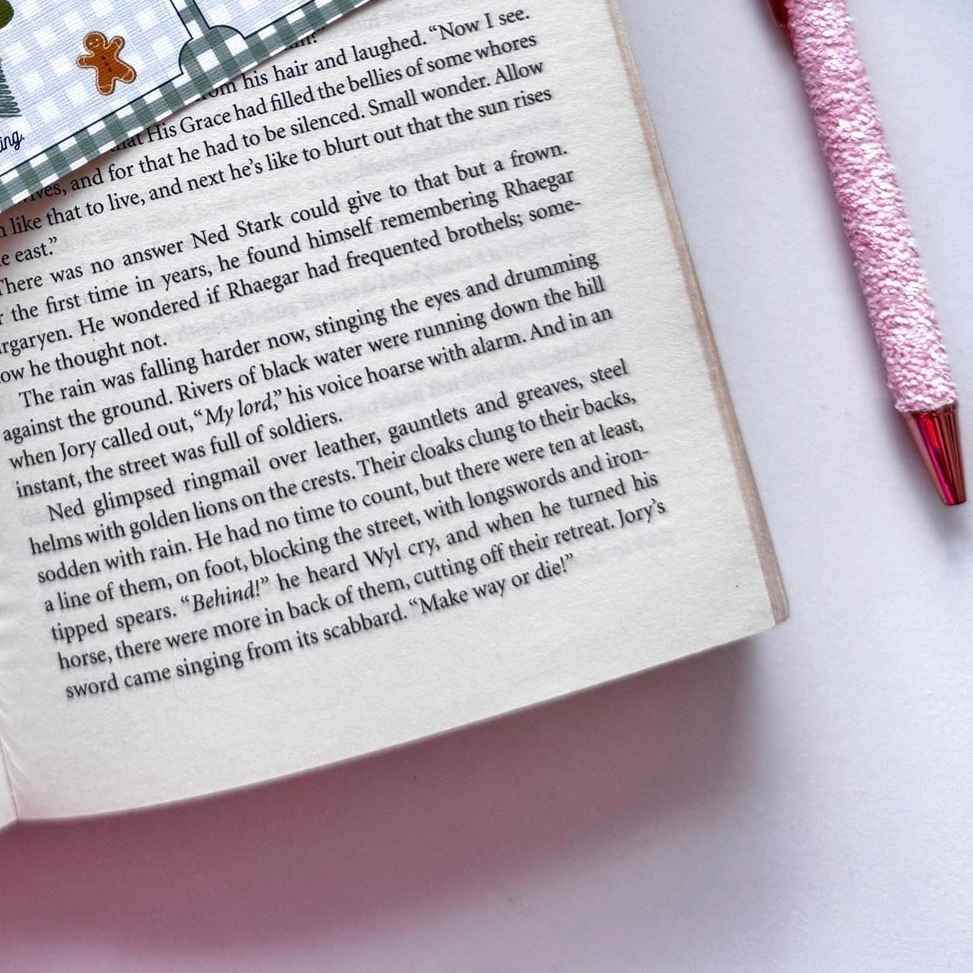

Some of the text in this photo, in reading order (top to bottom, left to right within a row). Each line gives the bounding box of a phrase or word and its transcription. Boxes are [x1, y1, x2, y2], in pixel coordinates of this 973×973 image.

[49, 264, 84, 284] was
[90, 257, 115, 275] no
[121, 239, 184, 267] answer
[189, 223, 231, 250] Ned
[235, 210, 285, 238] Stark
[290, 195, 341, 224] could
[347, 189, 383, 215] give
[387, 183, 408, 199] to
[413, 170, 451, 192] that
[454, 161, 488, 182] but
[493, 159, 506, 172] a
[510, 144, 568, 168] frown.
[16, 410, 343, 499] instant, the street was full of soldiers.
[50, 613, 109, 645] tipped
[115, 605, 177, 633] spears.
[276, 572, 301, 591] he
[305, 553, 360, 584] heard
[362, 541, 402, 568] Wyl
[407, 536, 441, 557] cry,
[445, 519, 481, 546] and
[485, 510, 535, 534] when
[538, 500, 562, 519] he
[567, 477, 628, 511] turned
[630, 473, 660, 492] his
[65, 671, 120, 699] sword
[123, 666, 172, 688] came
[175, 650, 245, 678] singing
[246, 638, 294, 661] from
[296, 630, 320, 649] its
[322, 602, 408, 642] scabbard.
[471, 578, 506, 599] way
[511, 571, 530, 588] or
